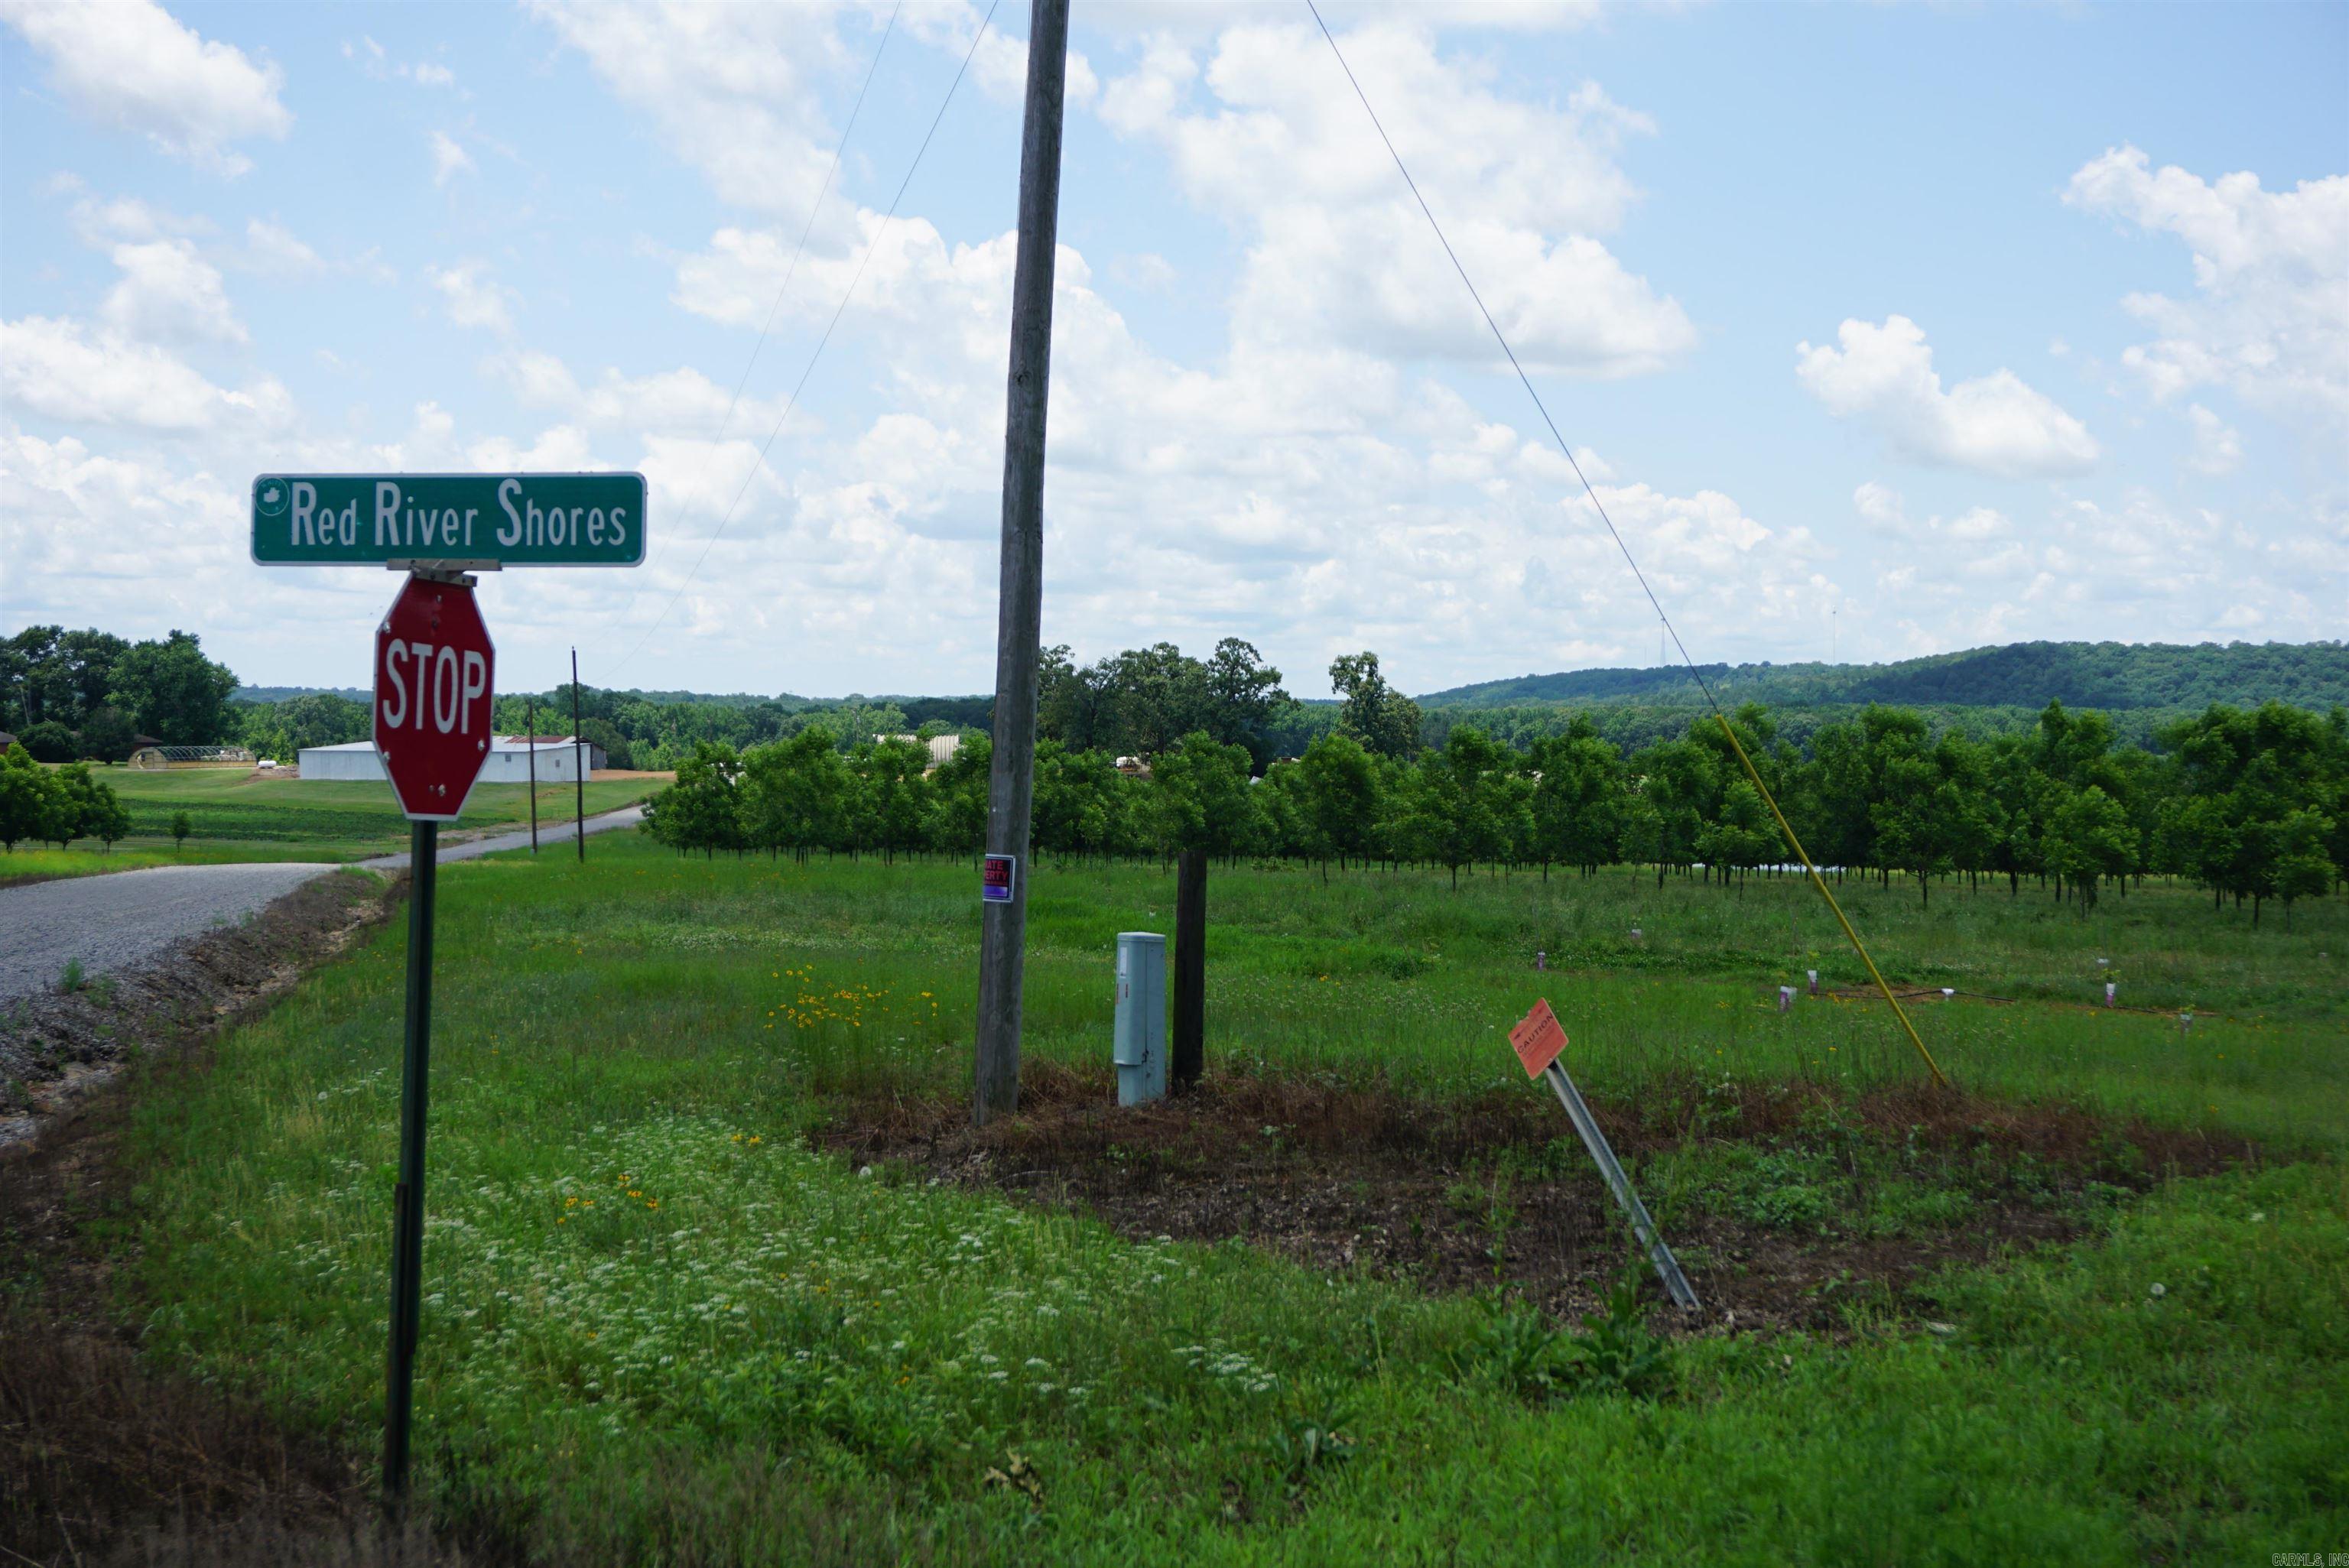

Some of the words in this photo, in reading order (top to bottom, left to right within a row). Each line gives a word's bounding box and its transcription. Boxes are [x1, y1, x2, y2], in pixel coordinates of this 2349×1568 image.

[291, 482, 357, 546] Red
[375, 482, 479, 546] River
[497, 479, 626, 547] Shores
[382, 638, 486, 734] STOP
[1517, 1014, 1554, 1053] CAUTION
